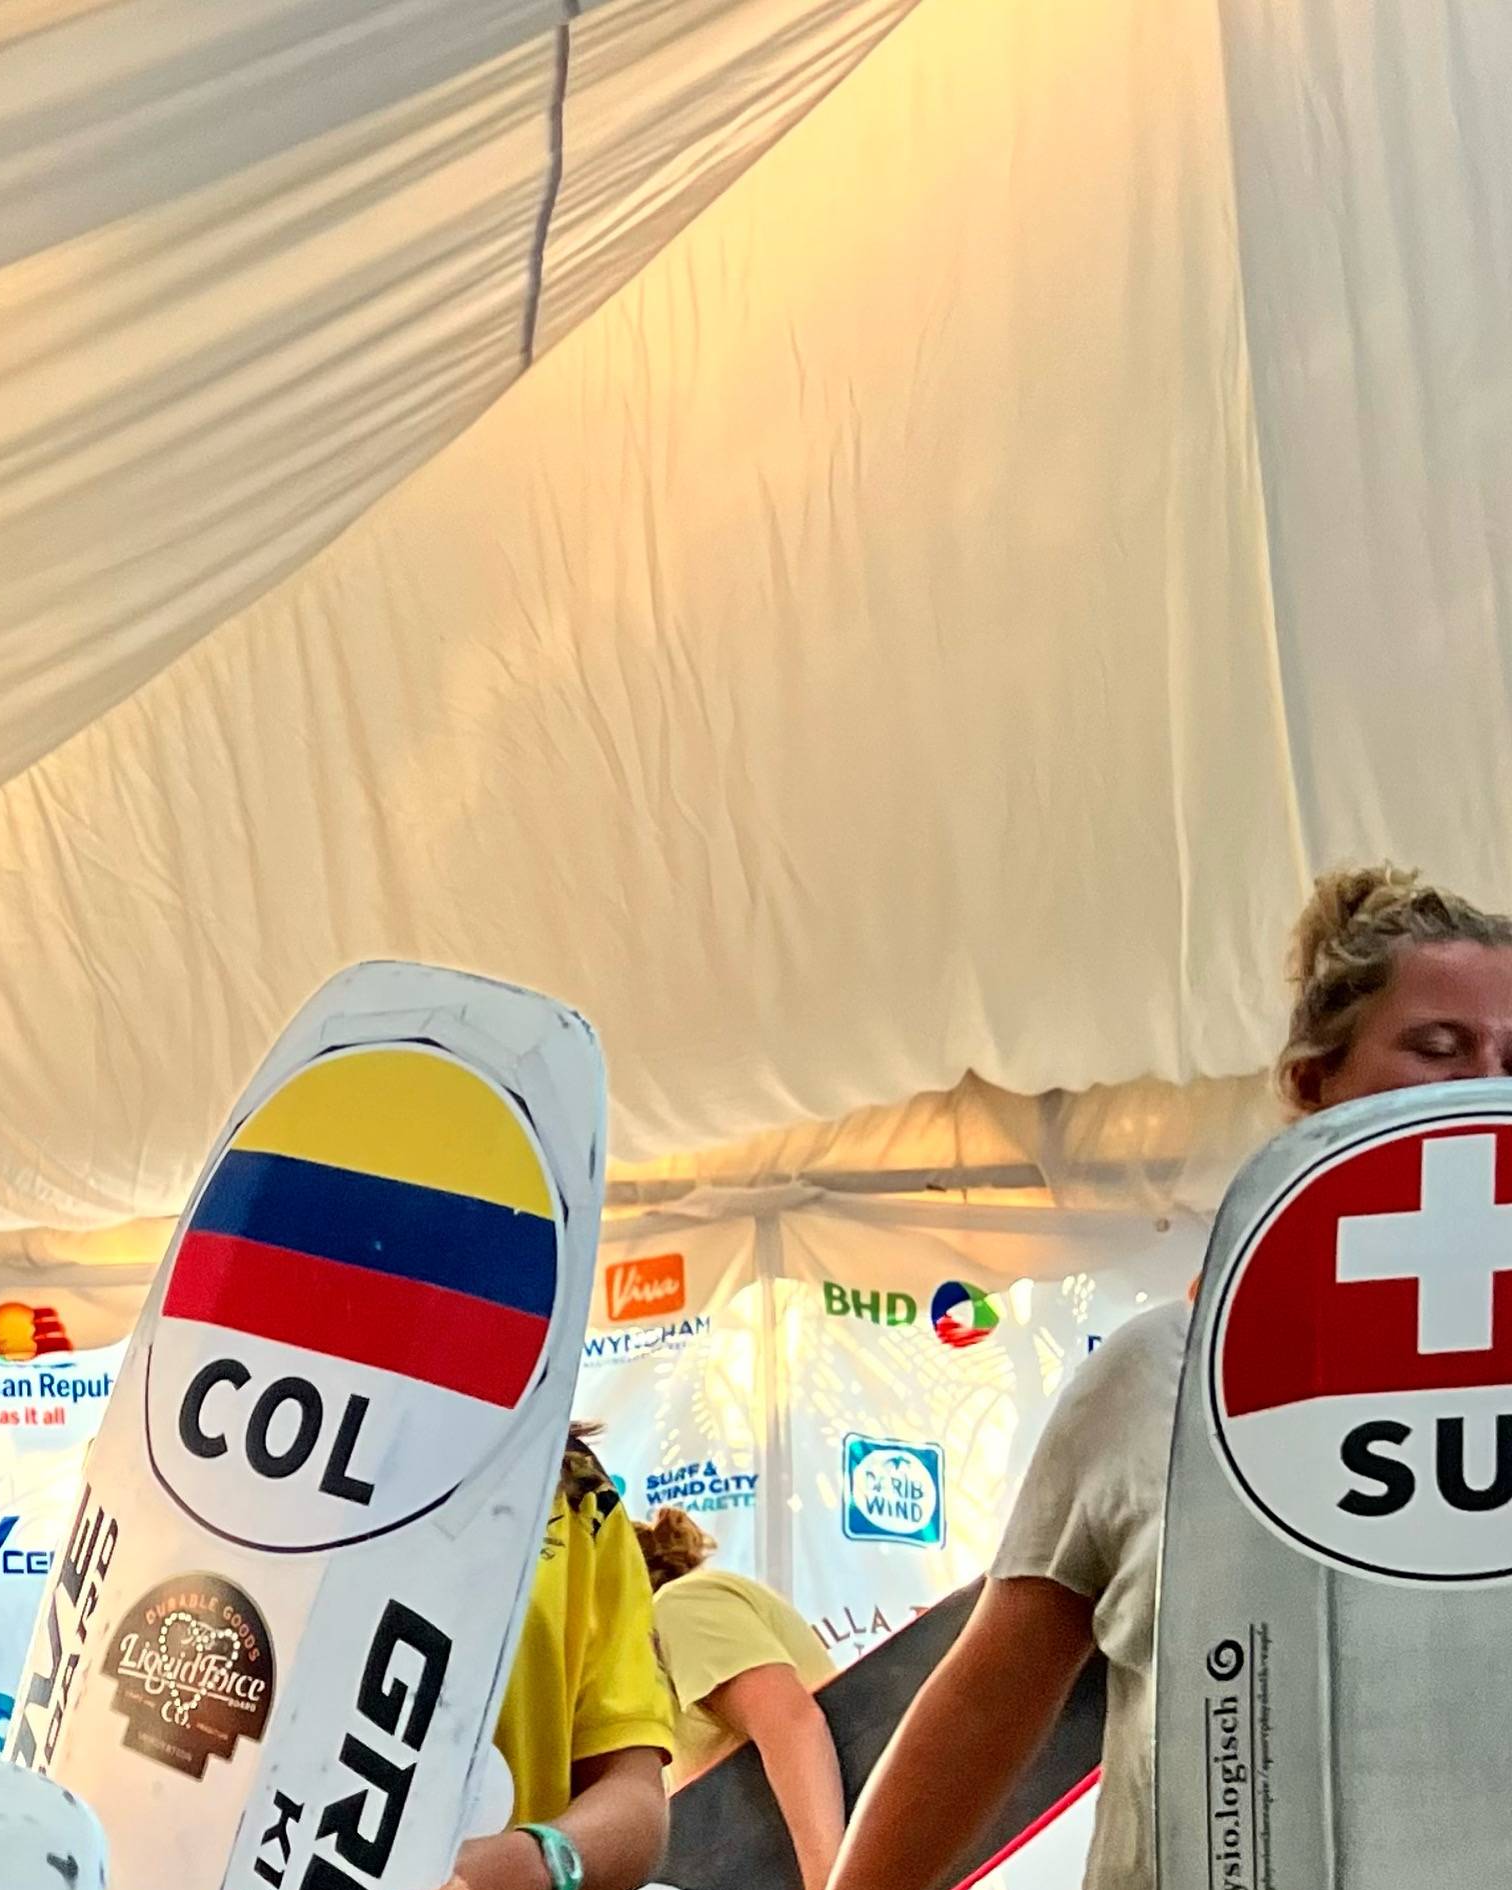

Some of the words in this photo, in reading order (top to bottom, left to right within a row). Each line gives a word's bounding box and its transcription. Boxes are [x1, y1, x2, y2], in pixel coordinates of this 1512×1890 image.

[611, 1264, 679, 1318] Viva
[823, 1280, 917, 1326] BHD
[584, 1316, 710, 1356] WYHAM
[24, 1407, 38, 1425] it
[43, 1407, 65, 1425] all
[178, 1358, 376, 1506] COL
[646, 1463, 700, 1489] SURF
[703, 1460, 717, 1477] &
[646, 1480, 705, 1505] WIND
[709, 1474, 759, 1494] CITY
[864, 1495, 923, 1523] WIND
[144, 1594, 219, 1625] DURABLE
[222, 1606, 261, 1662] GOODS
